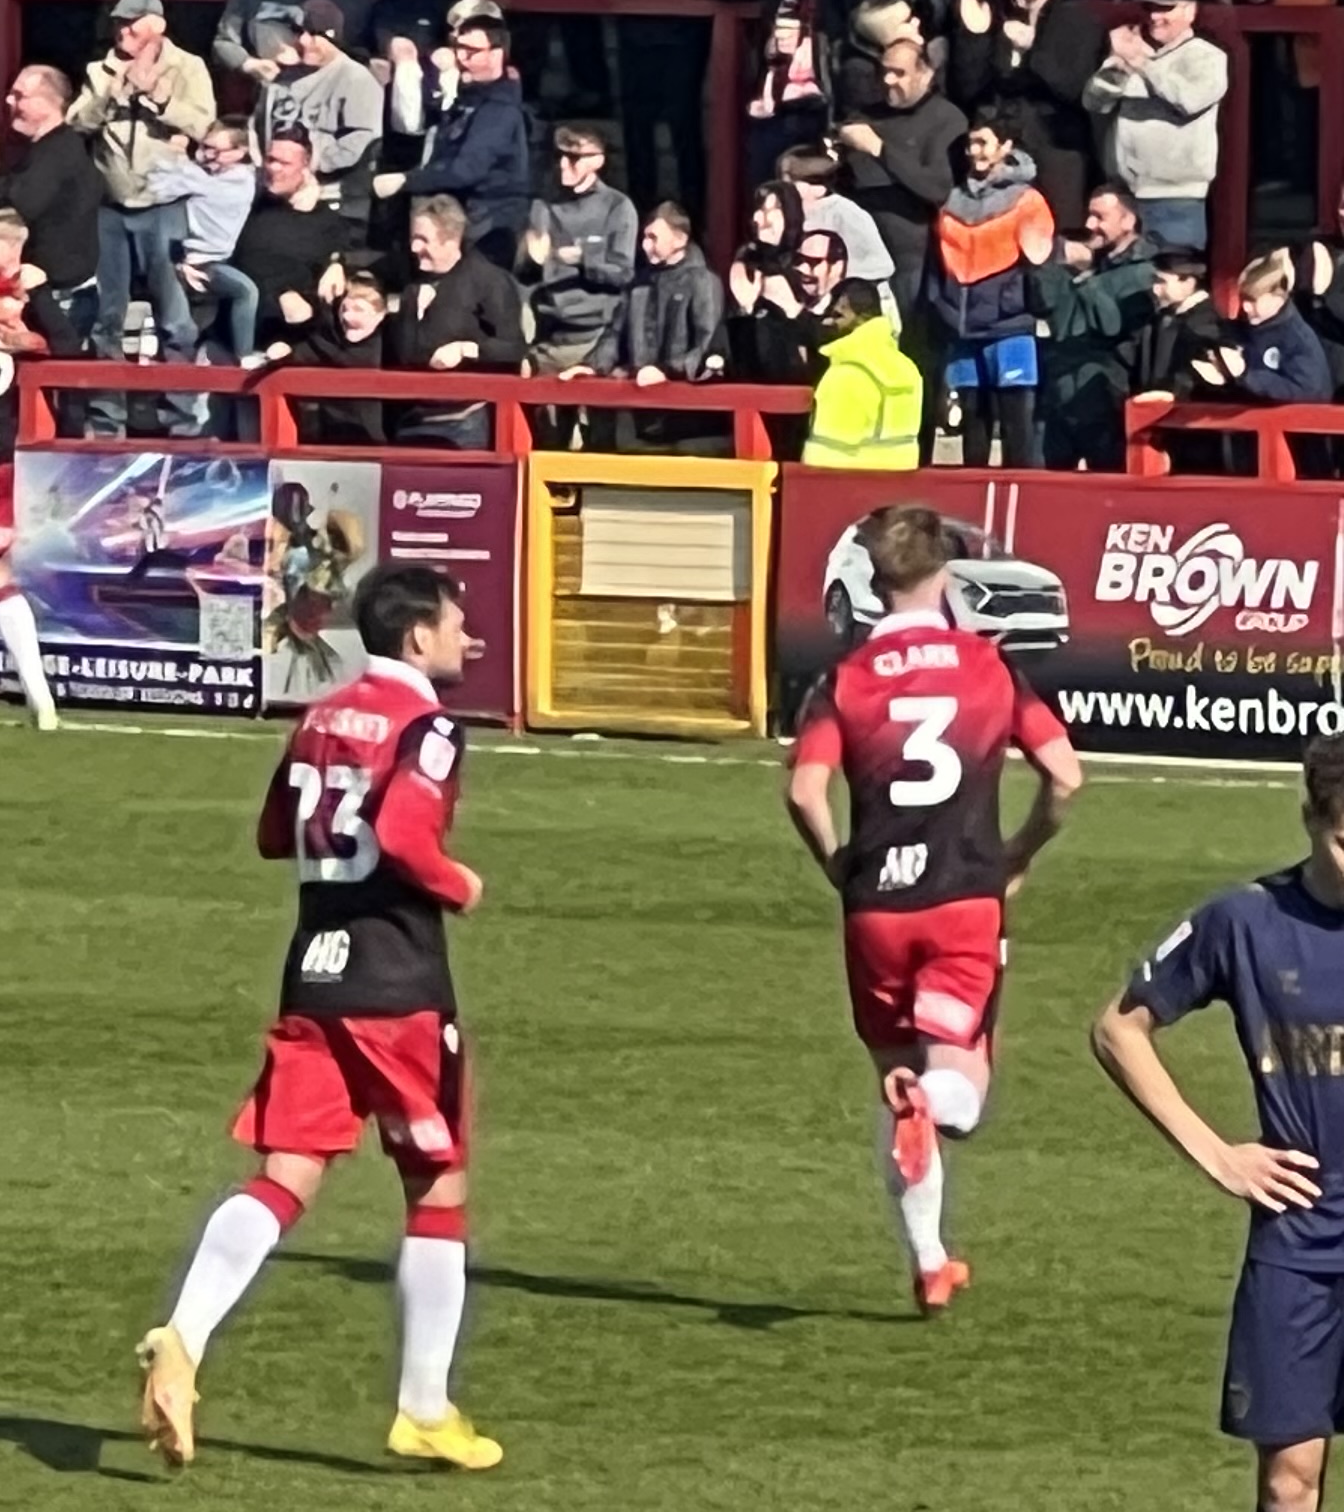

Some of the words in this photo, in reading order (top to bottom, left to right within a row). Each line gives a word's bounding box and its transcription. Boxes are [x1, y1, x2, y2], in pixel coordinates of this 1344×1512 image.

[1104, 522, 1175, 554] KEN
[1094, 551, 1320, 611] BROWN
[1234, 609, 1311, 633] GROUP
[873, 643, 961, 678] CLARK
[1127, 636, 1204, 673] Proud
[1214, 649, 1238, 673] to
[1245, 644, 1277, 674] be
[1058, 684, 1344, 737] www.kenbro
[888, 696, 963, 807] 3
